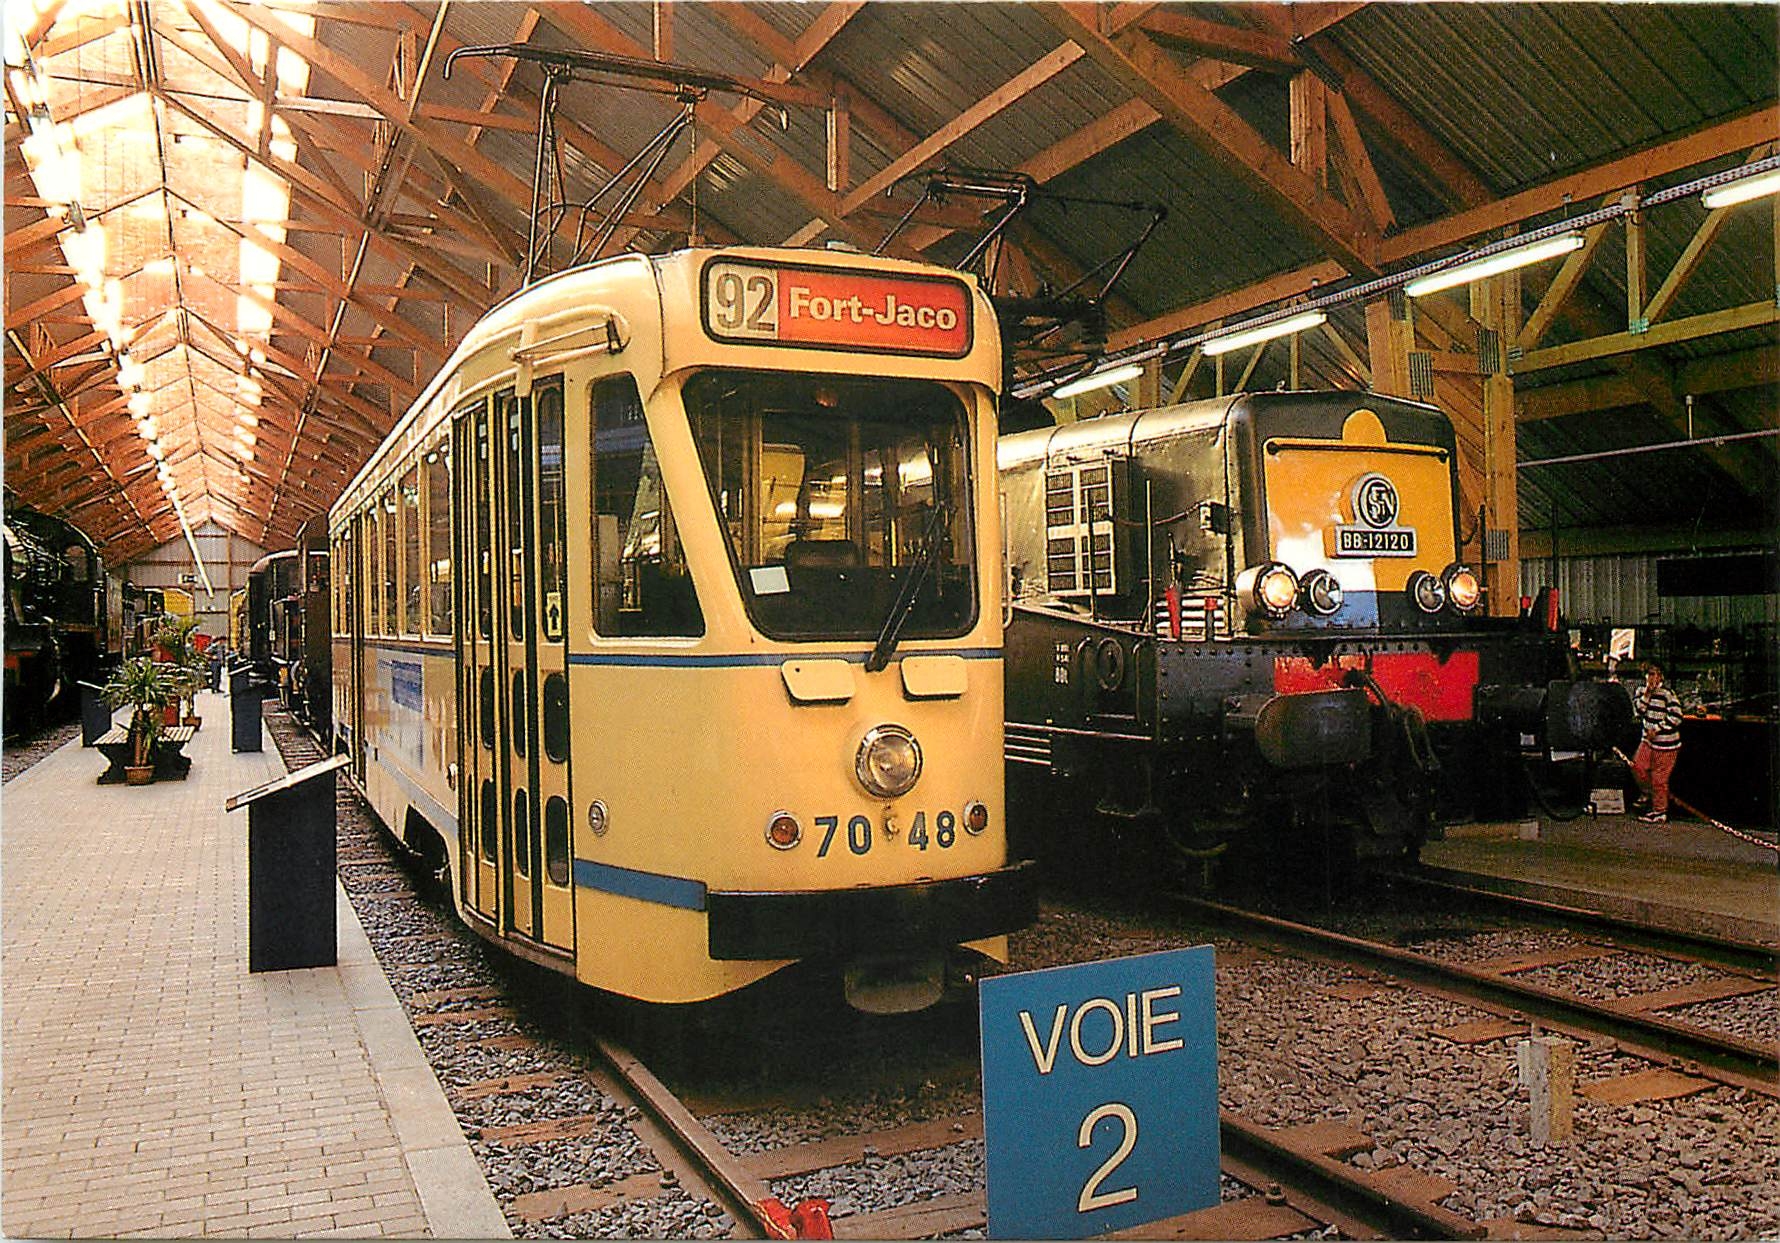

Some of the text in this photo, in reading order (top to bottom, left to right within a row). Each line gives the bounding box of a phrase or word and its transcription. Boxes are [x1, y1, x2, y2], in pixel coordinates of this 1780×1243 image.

[716, 272, 957, 332] 92 Fort-Jaco
[1343, 532, 1409, 550] BB-12120
[1019, 985, 1185, 1075] VOIE
[1077, 1101, 1139, 1213] 2
